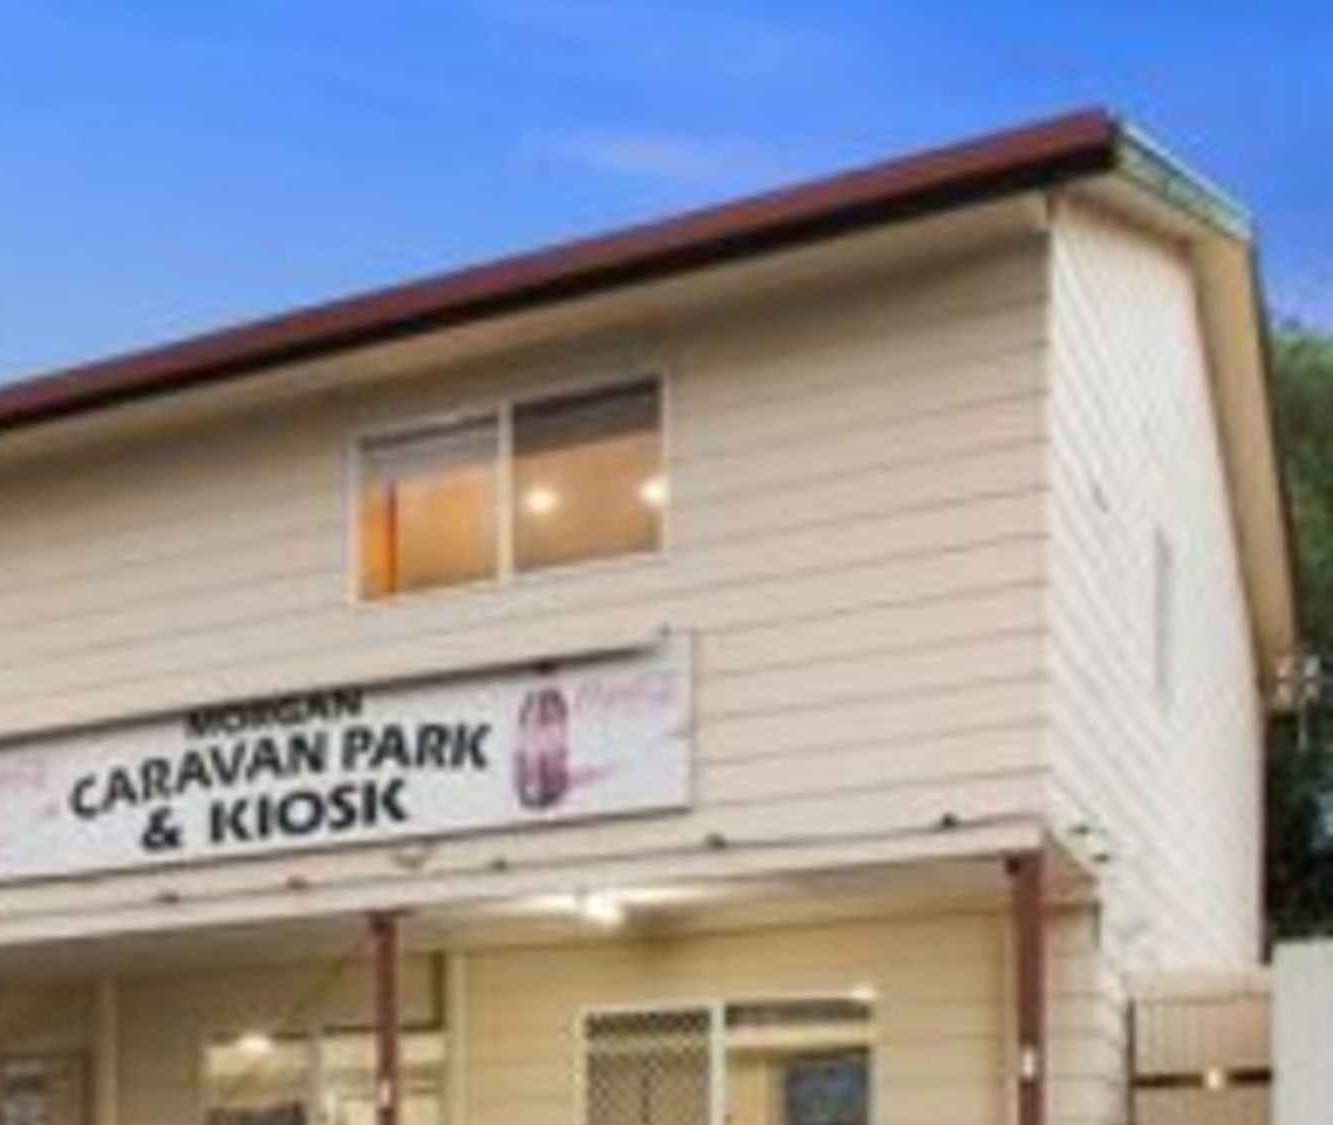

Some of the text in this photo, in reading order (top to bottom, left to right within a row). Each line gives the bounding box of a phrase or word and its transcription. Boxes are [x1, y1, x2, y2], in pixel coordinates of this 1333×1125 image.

[69, 723, 492, 819] CARAVAN PARK
[142, 779, 410, 853] & KIOSK
